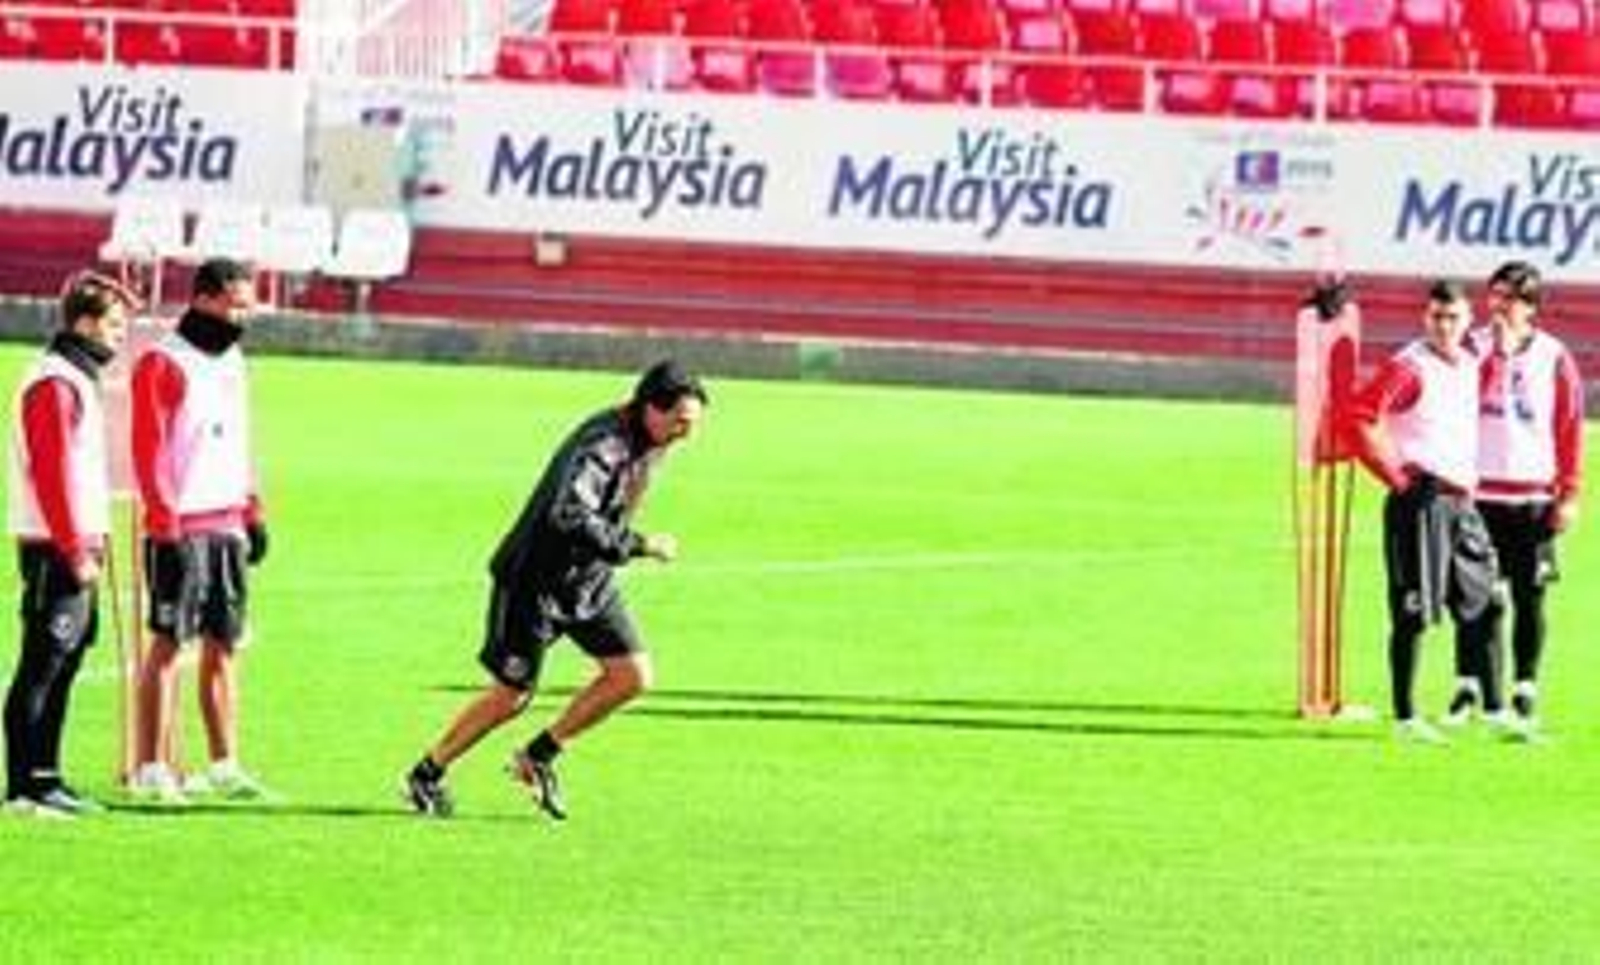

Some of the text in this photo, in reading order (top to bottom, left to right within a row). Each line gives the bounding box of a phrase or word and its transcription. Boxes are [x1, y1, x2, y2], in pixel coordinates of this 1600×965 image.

[78, 86, 183, 132] Visit
[613, 109, 715, 155] Visit
[487, 134, 768, 219] Malaysia
[956, 128, 1060, 177] Visit
[828, 154, 1112, 239] Malaysia
[1395, 179, 1600, 266] Malay
